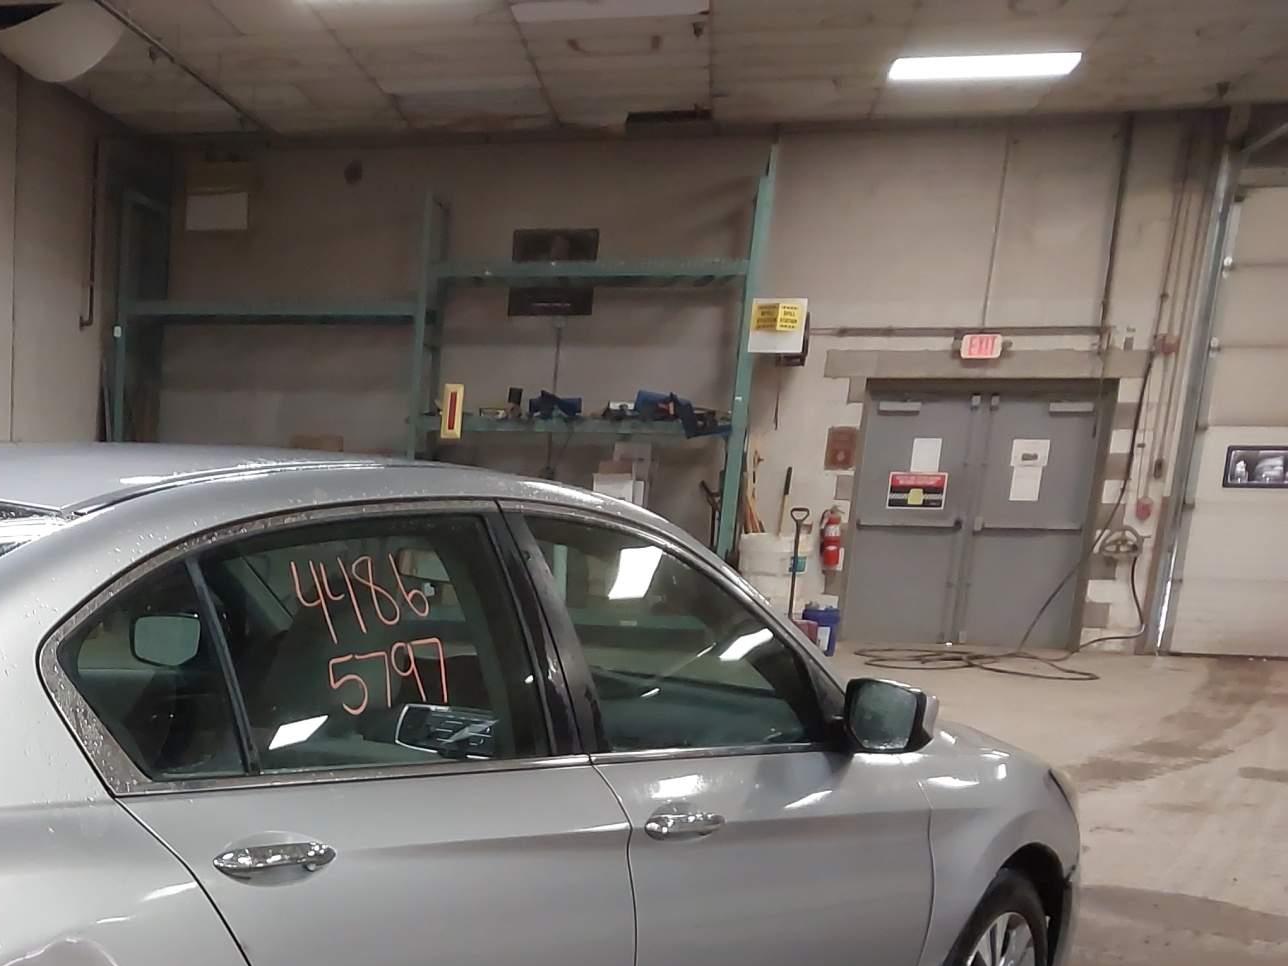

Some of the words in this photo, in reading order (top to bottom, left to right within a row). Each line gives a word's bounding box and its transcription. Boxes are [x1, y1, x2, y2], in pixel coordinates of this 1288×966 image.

[968, 335, 999, 357] EXIT
[290, 552, 430, 645] 4486
[328, 637, 448, 715] 5797
